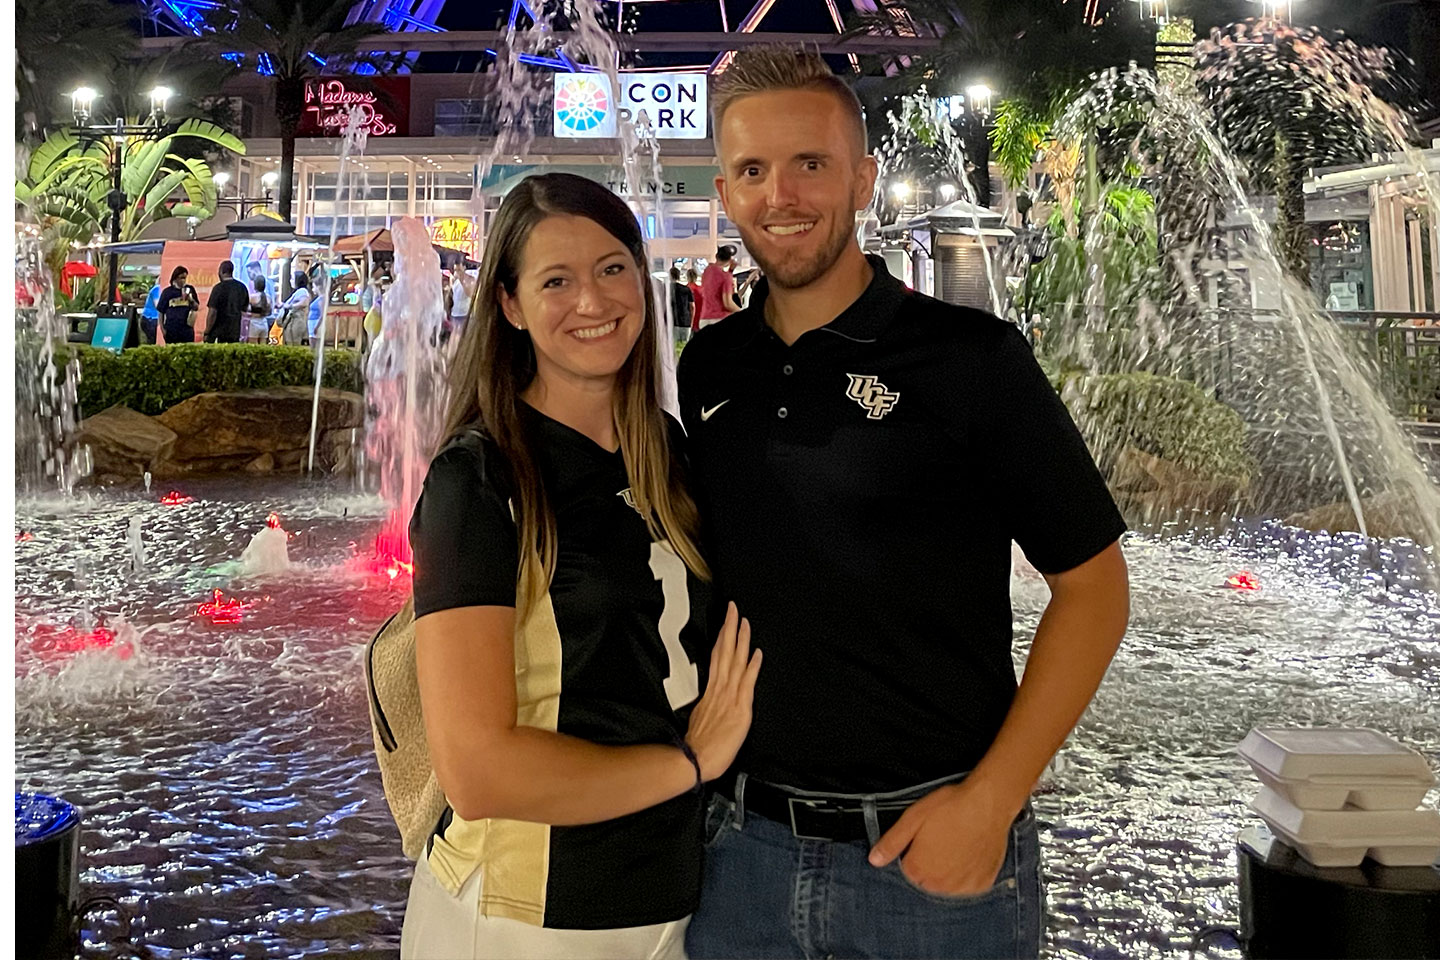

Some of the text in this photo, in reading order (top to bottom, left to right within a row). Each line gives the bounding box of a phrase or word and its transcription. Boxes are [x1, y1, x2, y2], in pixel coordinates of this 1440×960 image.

[607, 182, 685, 194] TRNCE
[846, 372, 900, 420] UCF
[648, 539, 700, 712] 1
